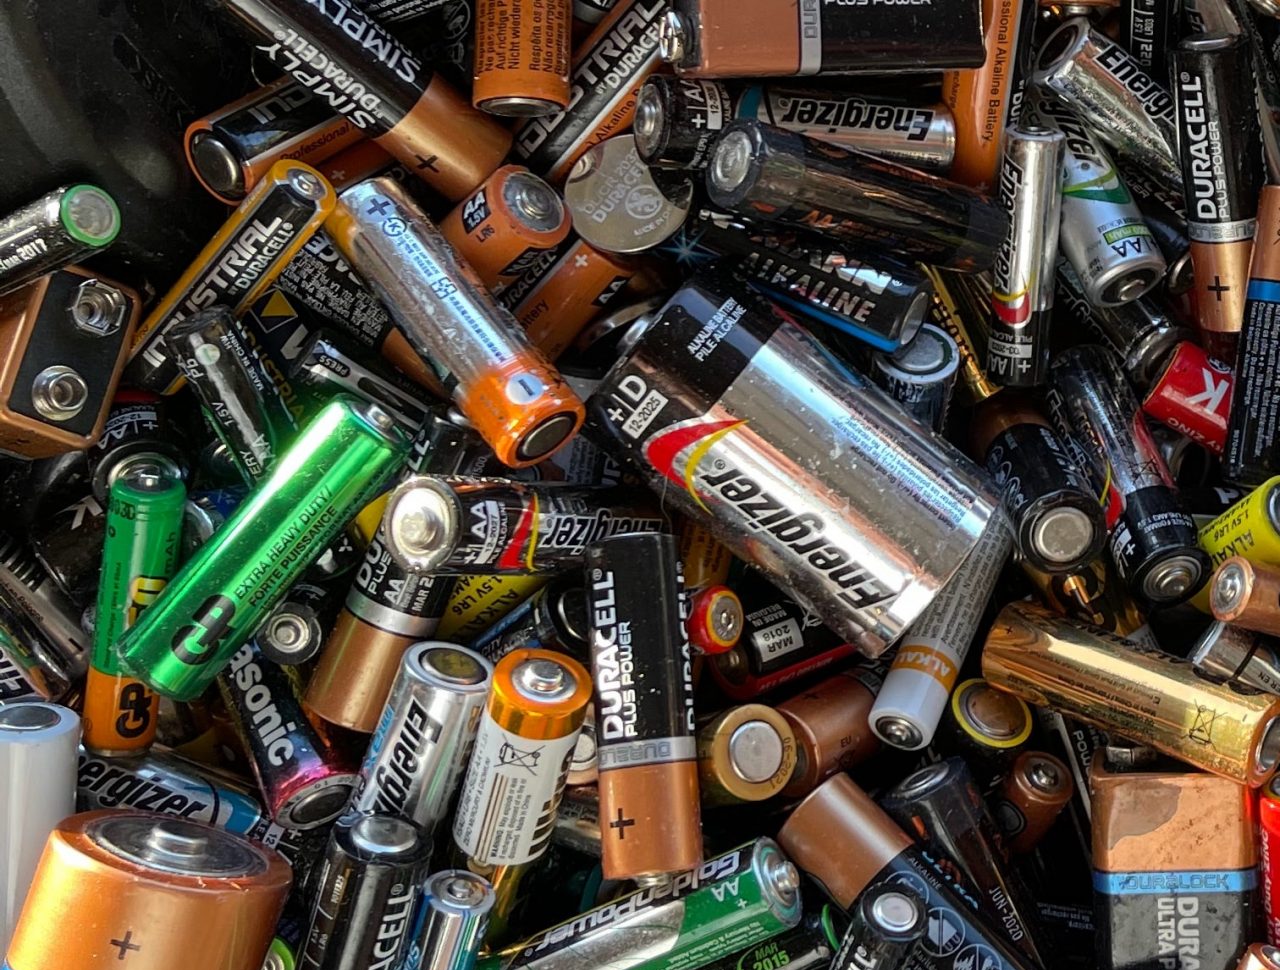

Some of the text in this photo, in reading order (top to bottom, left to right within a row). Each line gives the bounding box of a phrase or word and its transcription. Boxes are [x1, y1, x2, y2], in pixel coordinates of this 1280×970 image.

[256, 42, 376, 128] SIMPLY
[989, 46, 1008, 98] Alkaline
[1211, 120, 1229, 222] PLUS POWER
[462, 189, 487, 216] AA
[465, 204, 488, 229] 1.5V
[317, 354, 349, 376] PRESS
[627, 396, 662, 434] 12-2025
[471, 501, 488, 538] AA
[235, 563, 271, 600] EXTRA
[268, 524, 302, 569] HEAVY
[249, 506, 340, 609] FORTE PUISSANCE
[619, 620, 638, 738] PLUS POWER
[711, 879, 739, 903] AA
[987, 886, 1025, 943] JUN-2020
[1157, 896, 1175, 953] ULTRA
